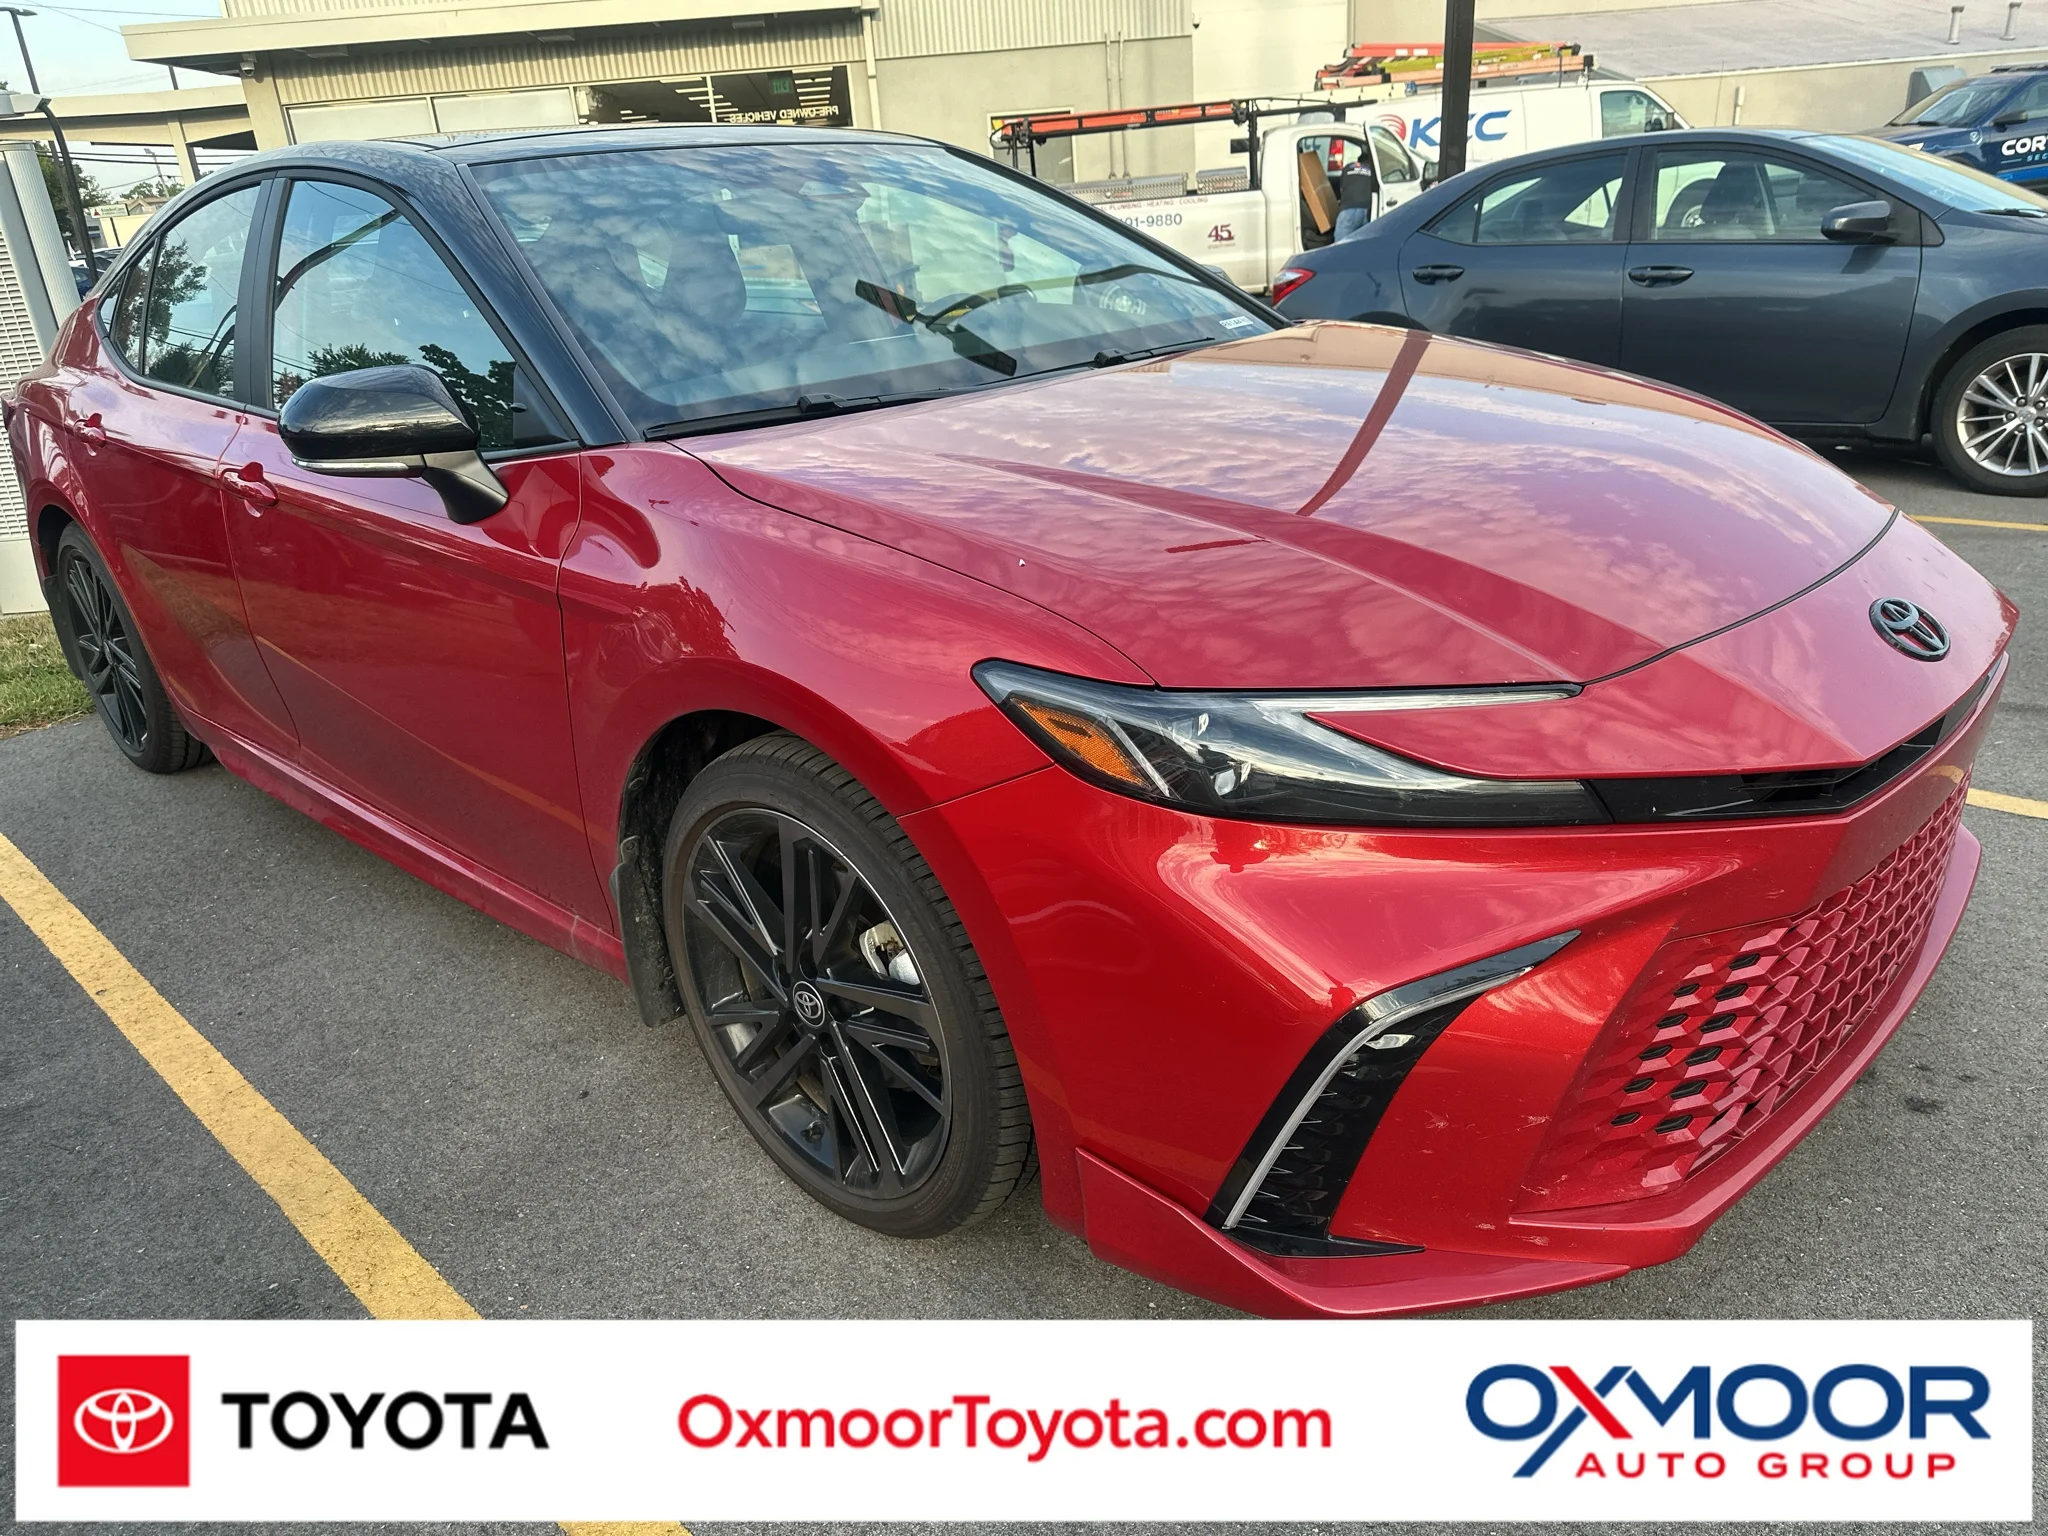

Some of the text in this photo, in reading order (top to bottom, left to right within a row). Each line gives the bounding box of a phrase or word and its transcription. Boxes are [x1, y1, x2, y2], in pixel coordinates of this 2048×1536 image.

[1409, 109, 1511, 149] KC
[2001, 134, 2048, 156] COR
[1109, 202, 1142, 211] PLUMBING
[1147, 199, 1174, 208] HEATING
[1179, 197, 1208, 206] COOLING
[1120, 213, 1183, 228] 01-9880
